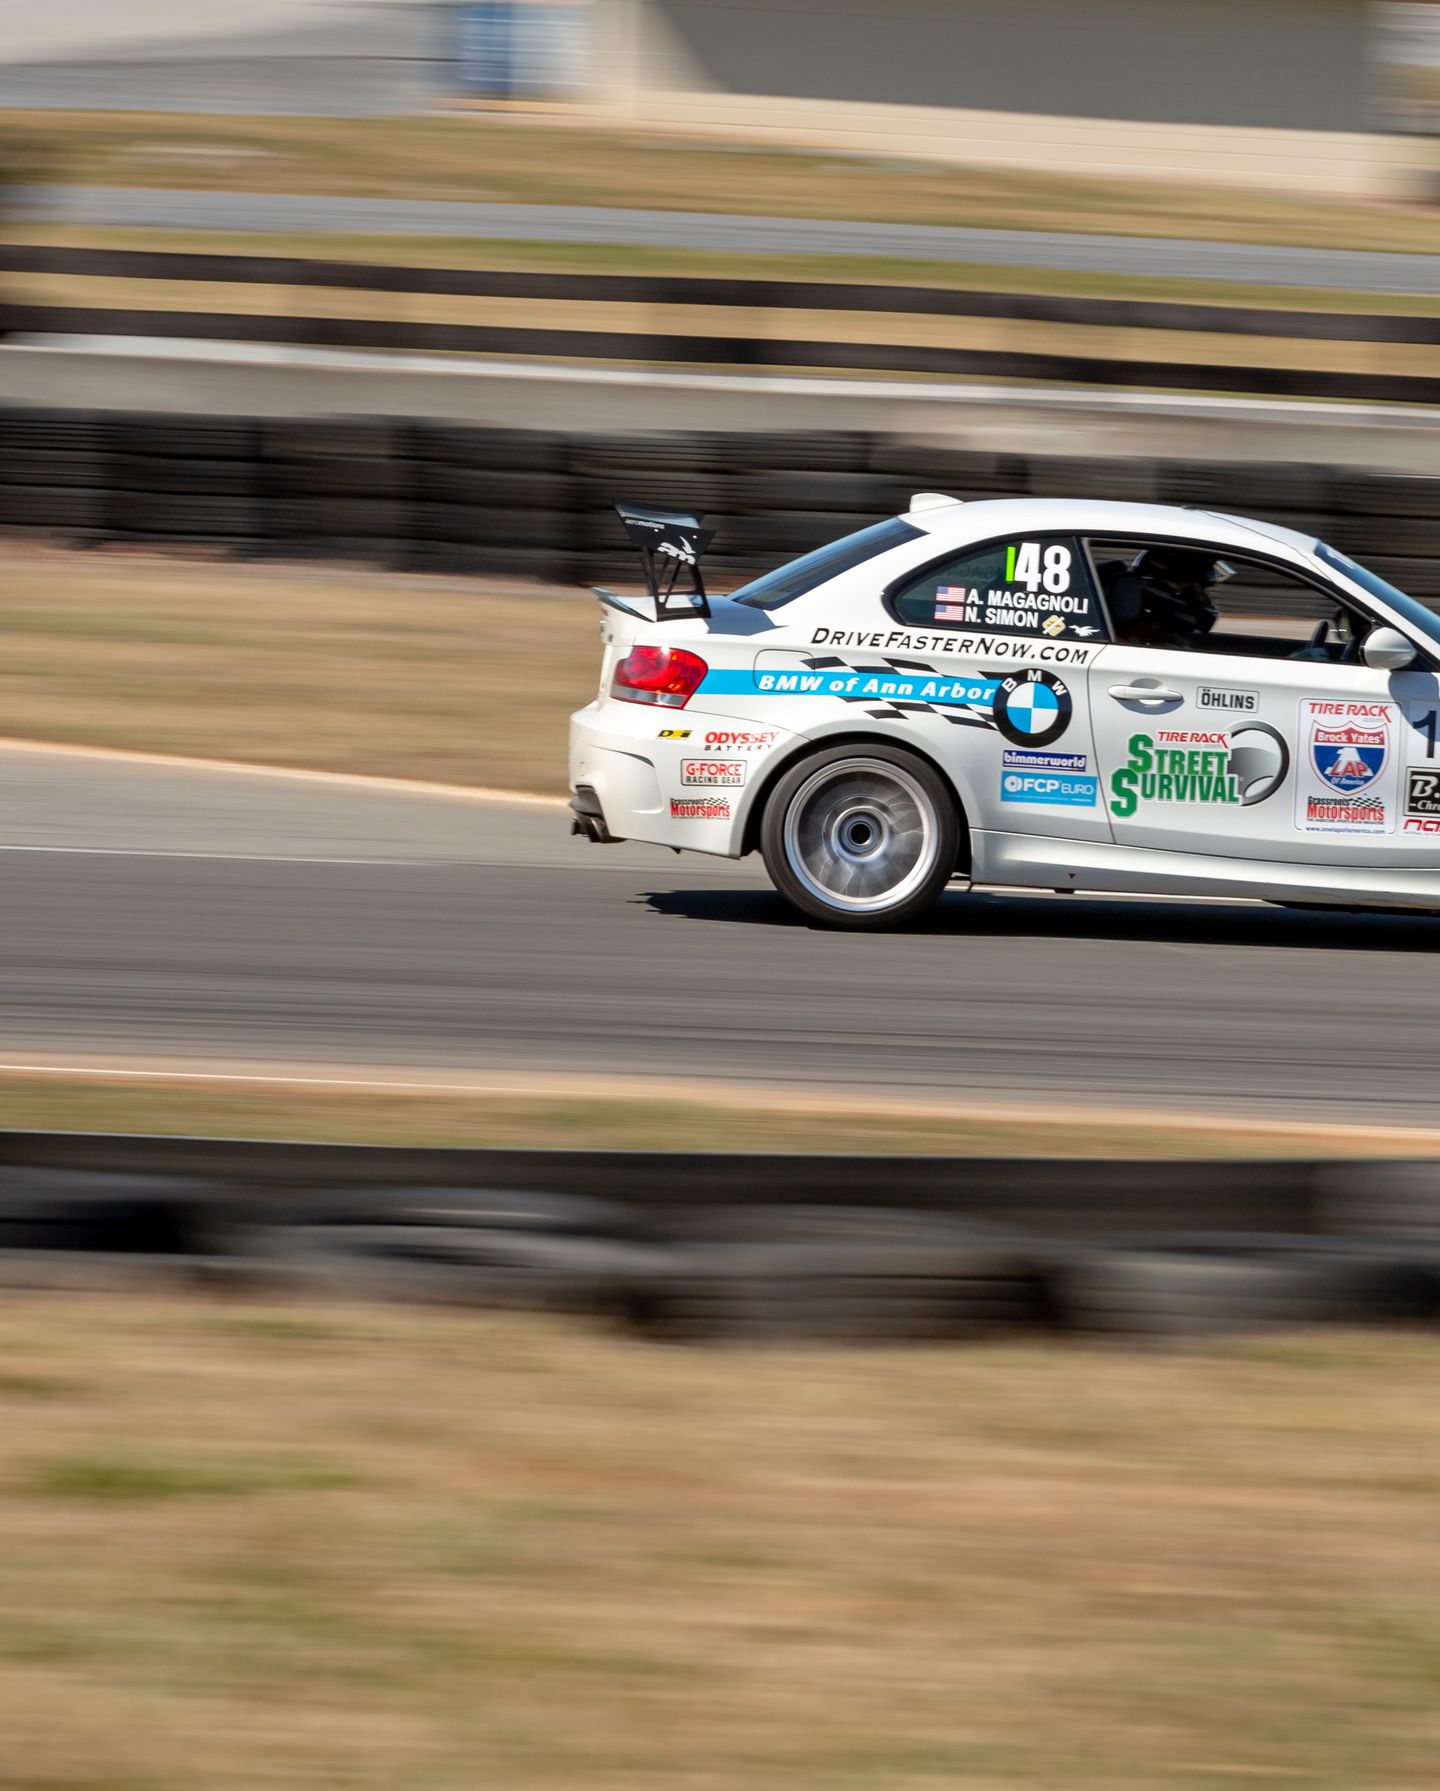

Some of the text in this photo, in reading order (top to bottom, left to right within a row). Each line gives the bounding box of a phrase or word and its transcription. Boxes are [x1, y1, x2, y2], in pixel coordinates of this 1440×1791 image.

[966, 588, 1089, 615] A. MAGAGNOLI
[965, 606, 1039, 628] N. SIMON
[758, 674, 996, 701] BMW of Ann Arbor
[1201, 689, 1255, 710] ÖHLINS
[1309, 703, 1392, 723] TIRE RACK
[704, 731, 780, 744] ODYSSEY
[1158, 731, 1229, 748] TIRE RACK
[1317, 732, 1348, 743] Brock
[1003, 752, 1086, 767] bimmerworld
[1127, 733, 1228, 776] STREET
[686, 763, 742, 776] G-FORCE
[1329, 760, 1369, 777] LAP
[1023, 778, 1095, 796] FCP EURO
[1111, 768, 1240, 817] SURVIVAL
[670, 804, 730, 818] Motorsports
[1307, 803, 1385, 822] Motorsports
